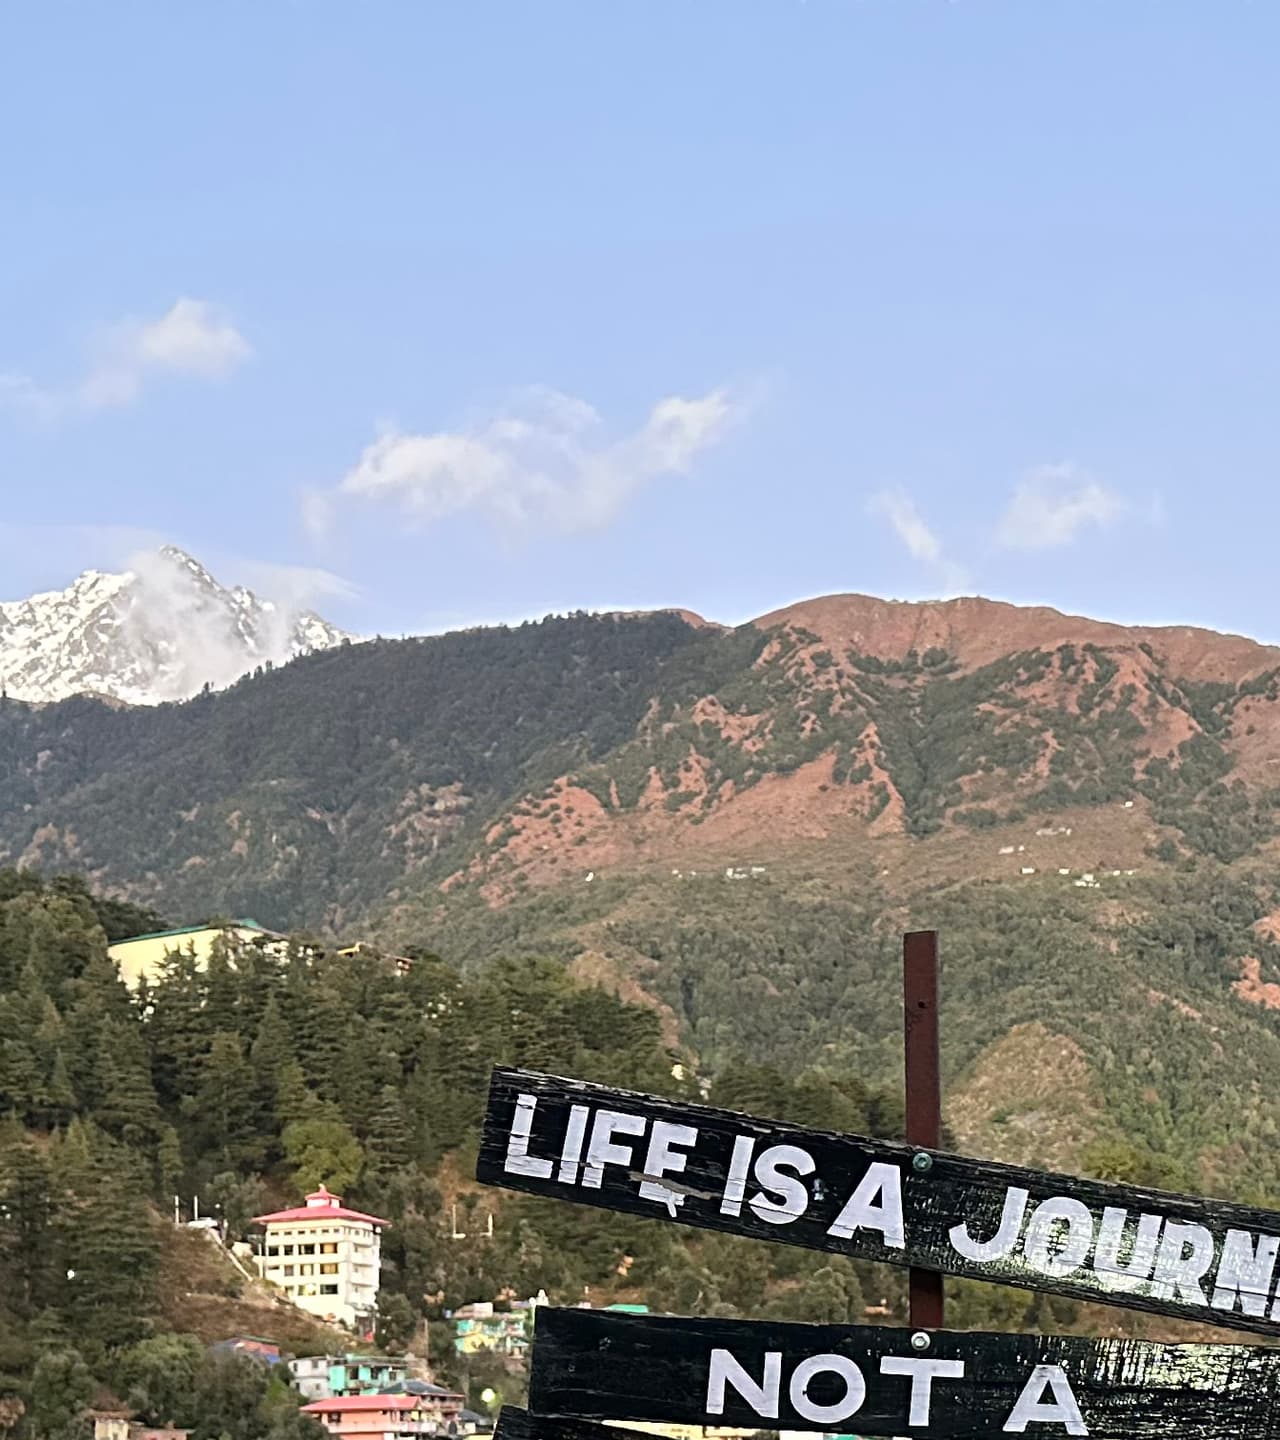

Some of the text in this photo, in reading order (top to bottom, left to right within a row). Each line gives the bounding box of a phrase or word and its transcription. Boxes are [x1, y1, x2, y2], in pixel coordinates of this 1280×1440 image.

[504, 1094, 699, 1216] LIFE
[719, 1134, 816, 1224] IS
[826, 1163, 907, 1249] A
[705, 1347, 1088, 1437] NOT A
